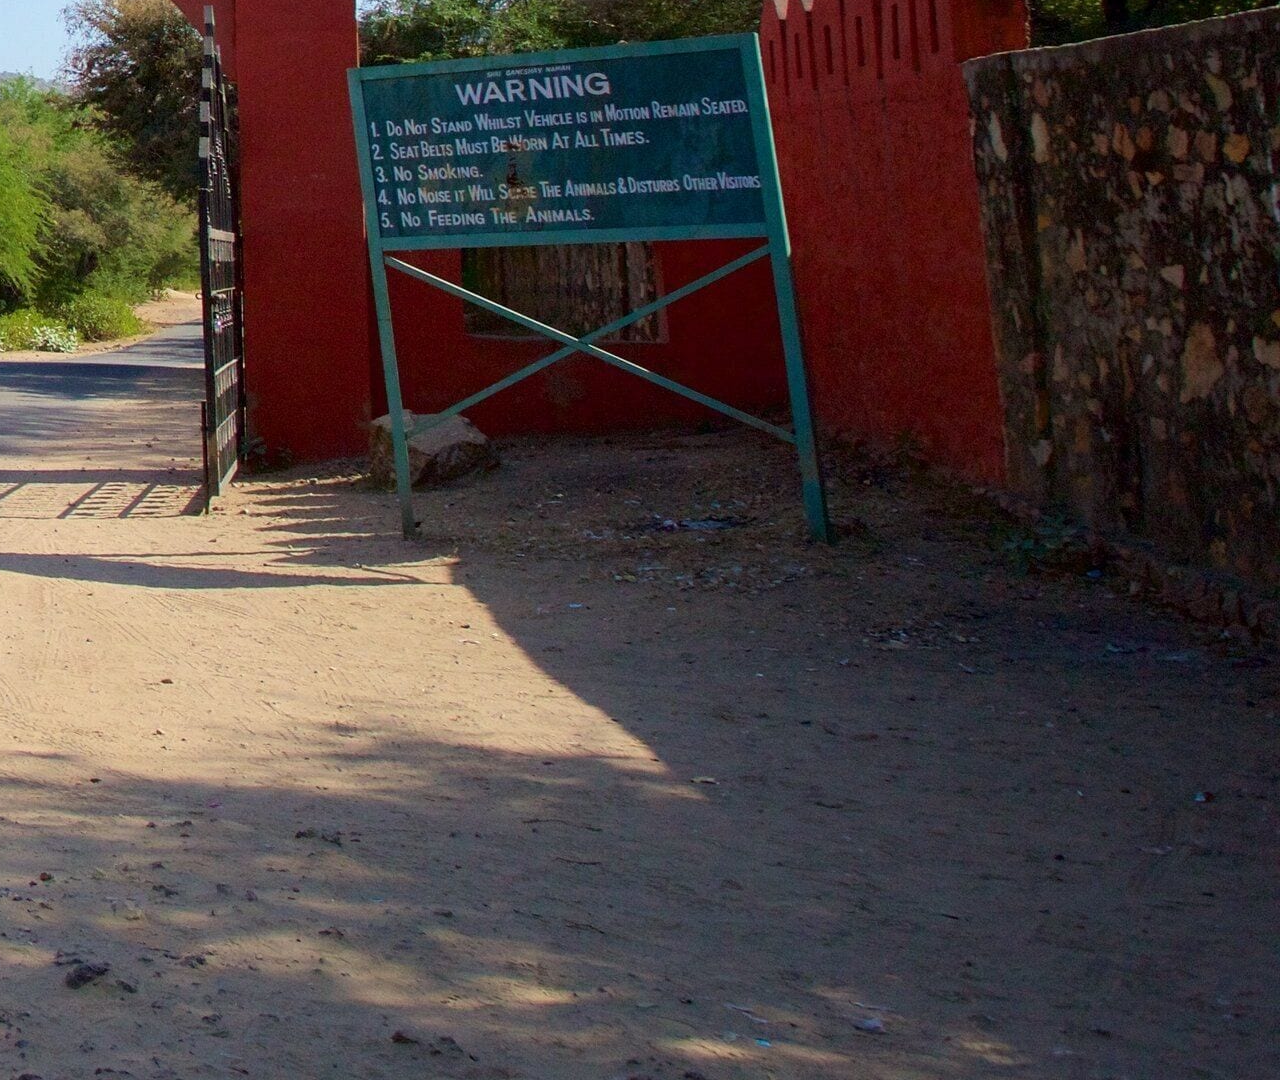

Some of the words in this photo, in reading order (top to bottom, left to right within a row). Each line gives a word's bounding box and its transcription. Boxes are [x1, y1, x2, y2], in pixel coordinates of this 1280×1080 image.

[455, 72, 611, 106] WARNING
[371, 122, 380, 137] 1.
[431, 117, 472, 134] STAND
[474, 113, 521, 131] WHILST
[524, 110, 573, 128] VEHICLE
[604, 104, 650, 121] MOTION
[651, 101, 700, 118] REMAIN
[371, 144, 383, 159] 2.
[455, 137, 488, 155] MUST
[552, 132, 570, 149] AT
[575, 131, 599, 148] ALL
[375, 167, 388, 183] 3.
[378, 191, 391, 205] 4.
[467, 184, 496, 201] WILL
[539, 181, 562, 198] THE
[381, 213, 393, 228] 5.
[428, 210, 485, 226] FEEDING
[491, 207, 517, 225] THE
